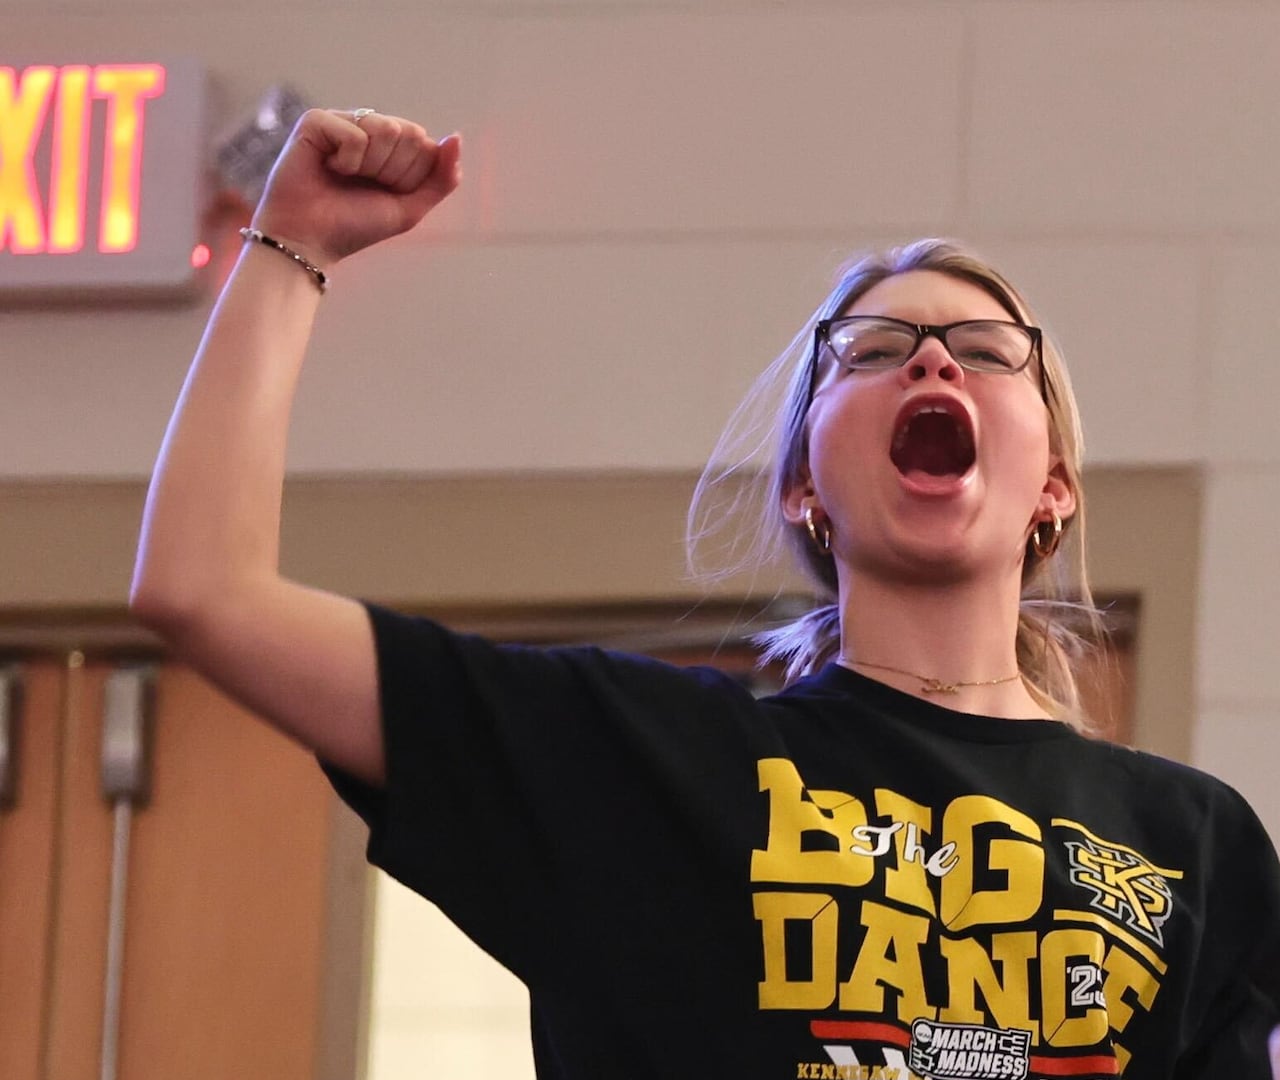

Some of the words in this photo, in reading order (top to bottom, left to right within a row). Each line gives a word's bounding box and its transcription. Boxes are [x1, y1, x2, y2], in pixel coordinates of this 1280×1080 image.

[0, 64, 166, 254] XIT
[750, 757, 1045, 931] BIG
[850, 822, 960, 877] The
[752, 892, 1160, 1075] DANCE
[931, 1028, 997, 1052] MARCH
[937, 1050, 1026, 1077] MADNESS
